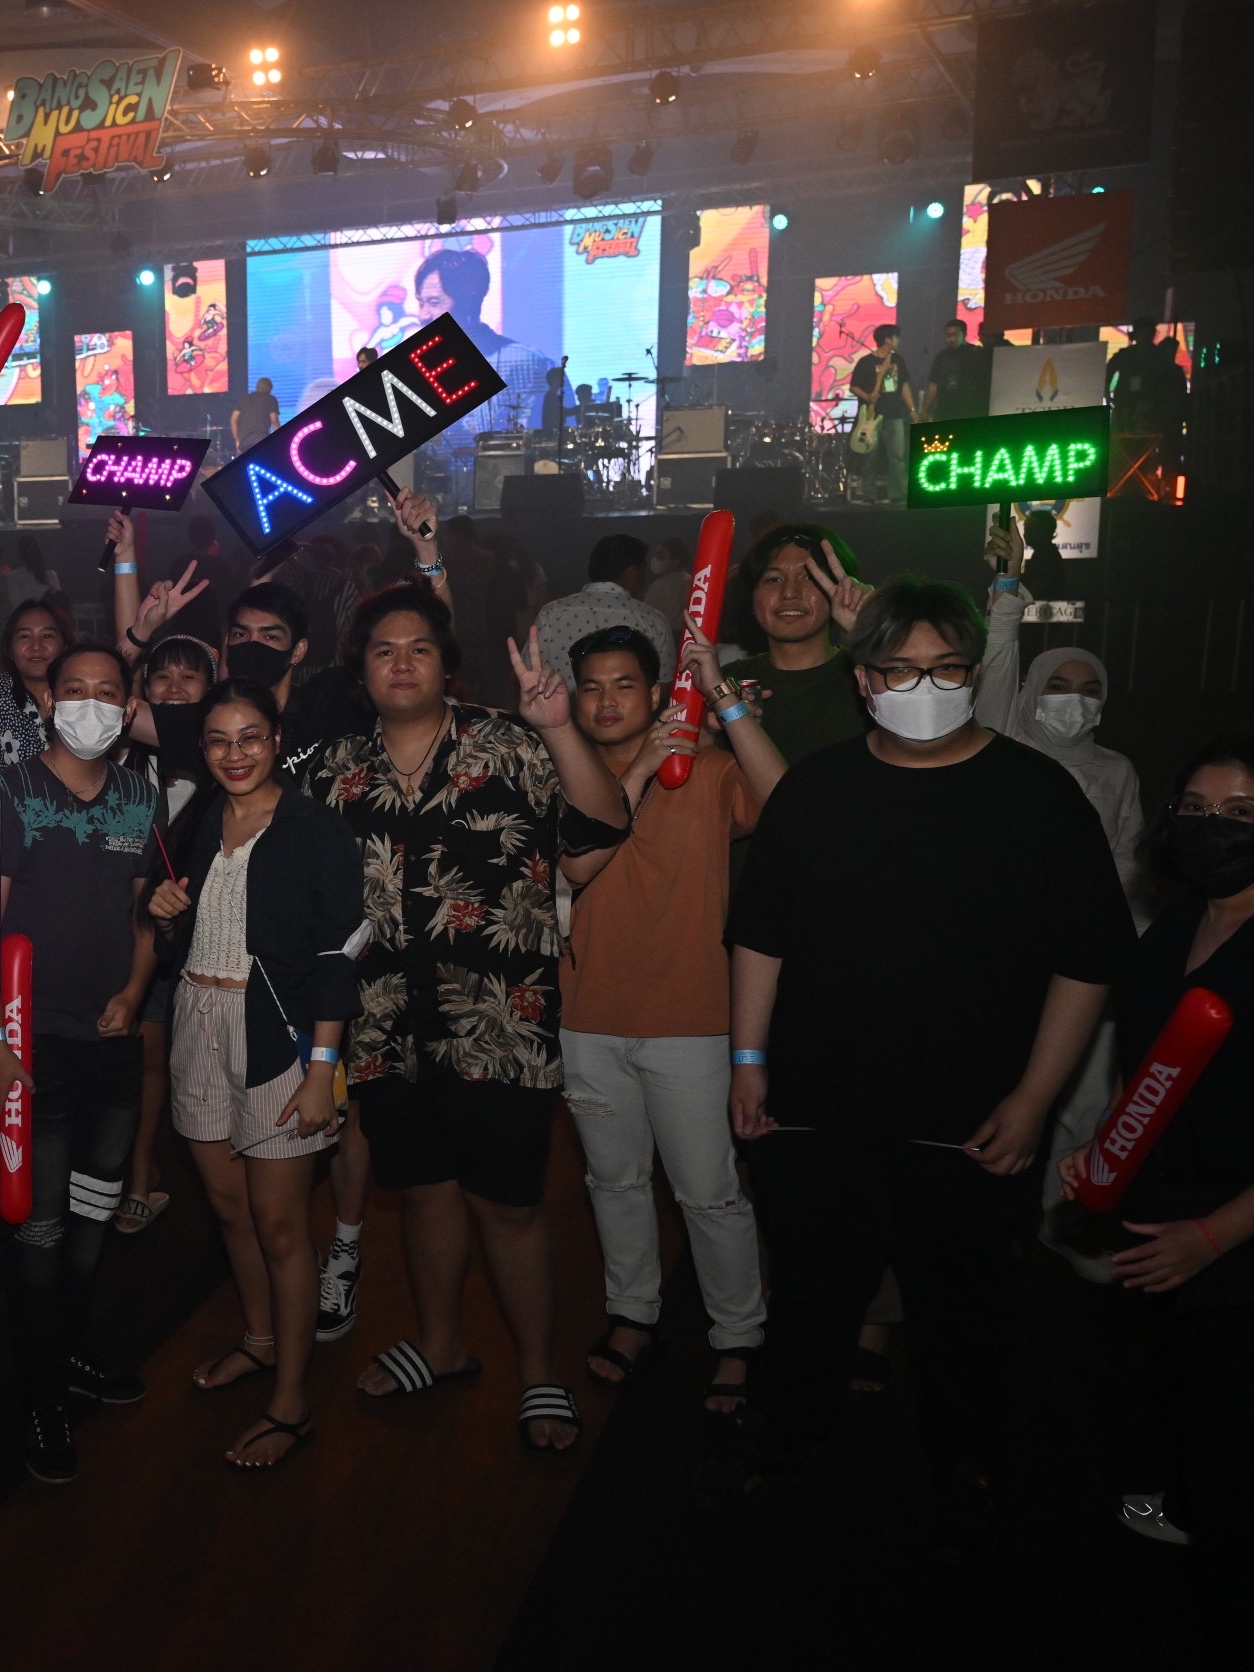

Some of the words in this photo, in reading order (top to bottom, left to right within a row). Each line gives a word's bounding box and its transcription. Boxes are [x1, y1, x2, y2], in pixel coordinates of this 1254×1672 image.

[1004, 285, 1106, 304] HONDA
[86, 453, 193, 488] CHAMP
[246, 334, 480, 535] ACME
[918, 443, 1096, 493] CHAMP
[5, 994, 22, 1128] HODA
[1103, 1061, 1181, 1160] HONDA
